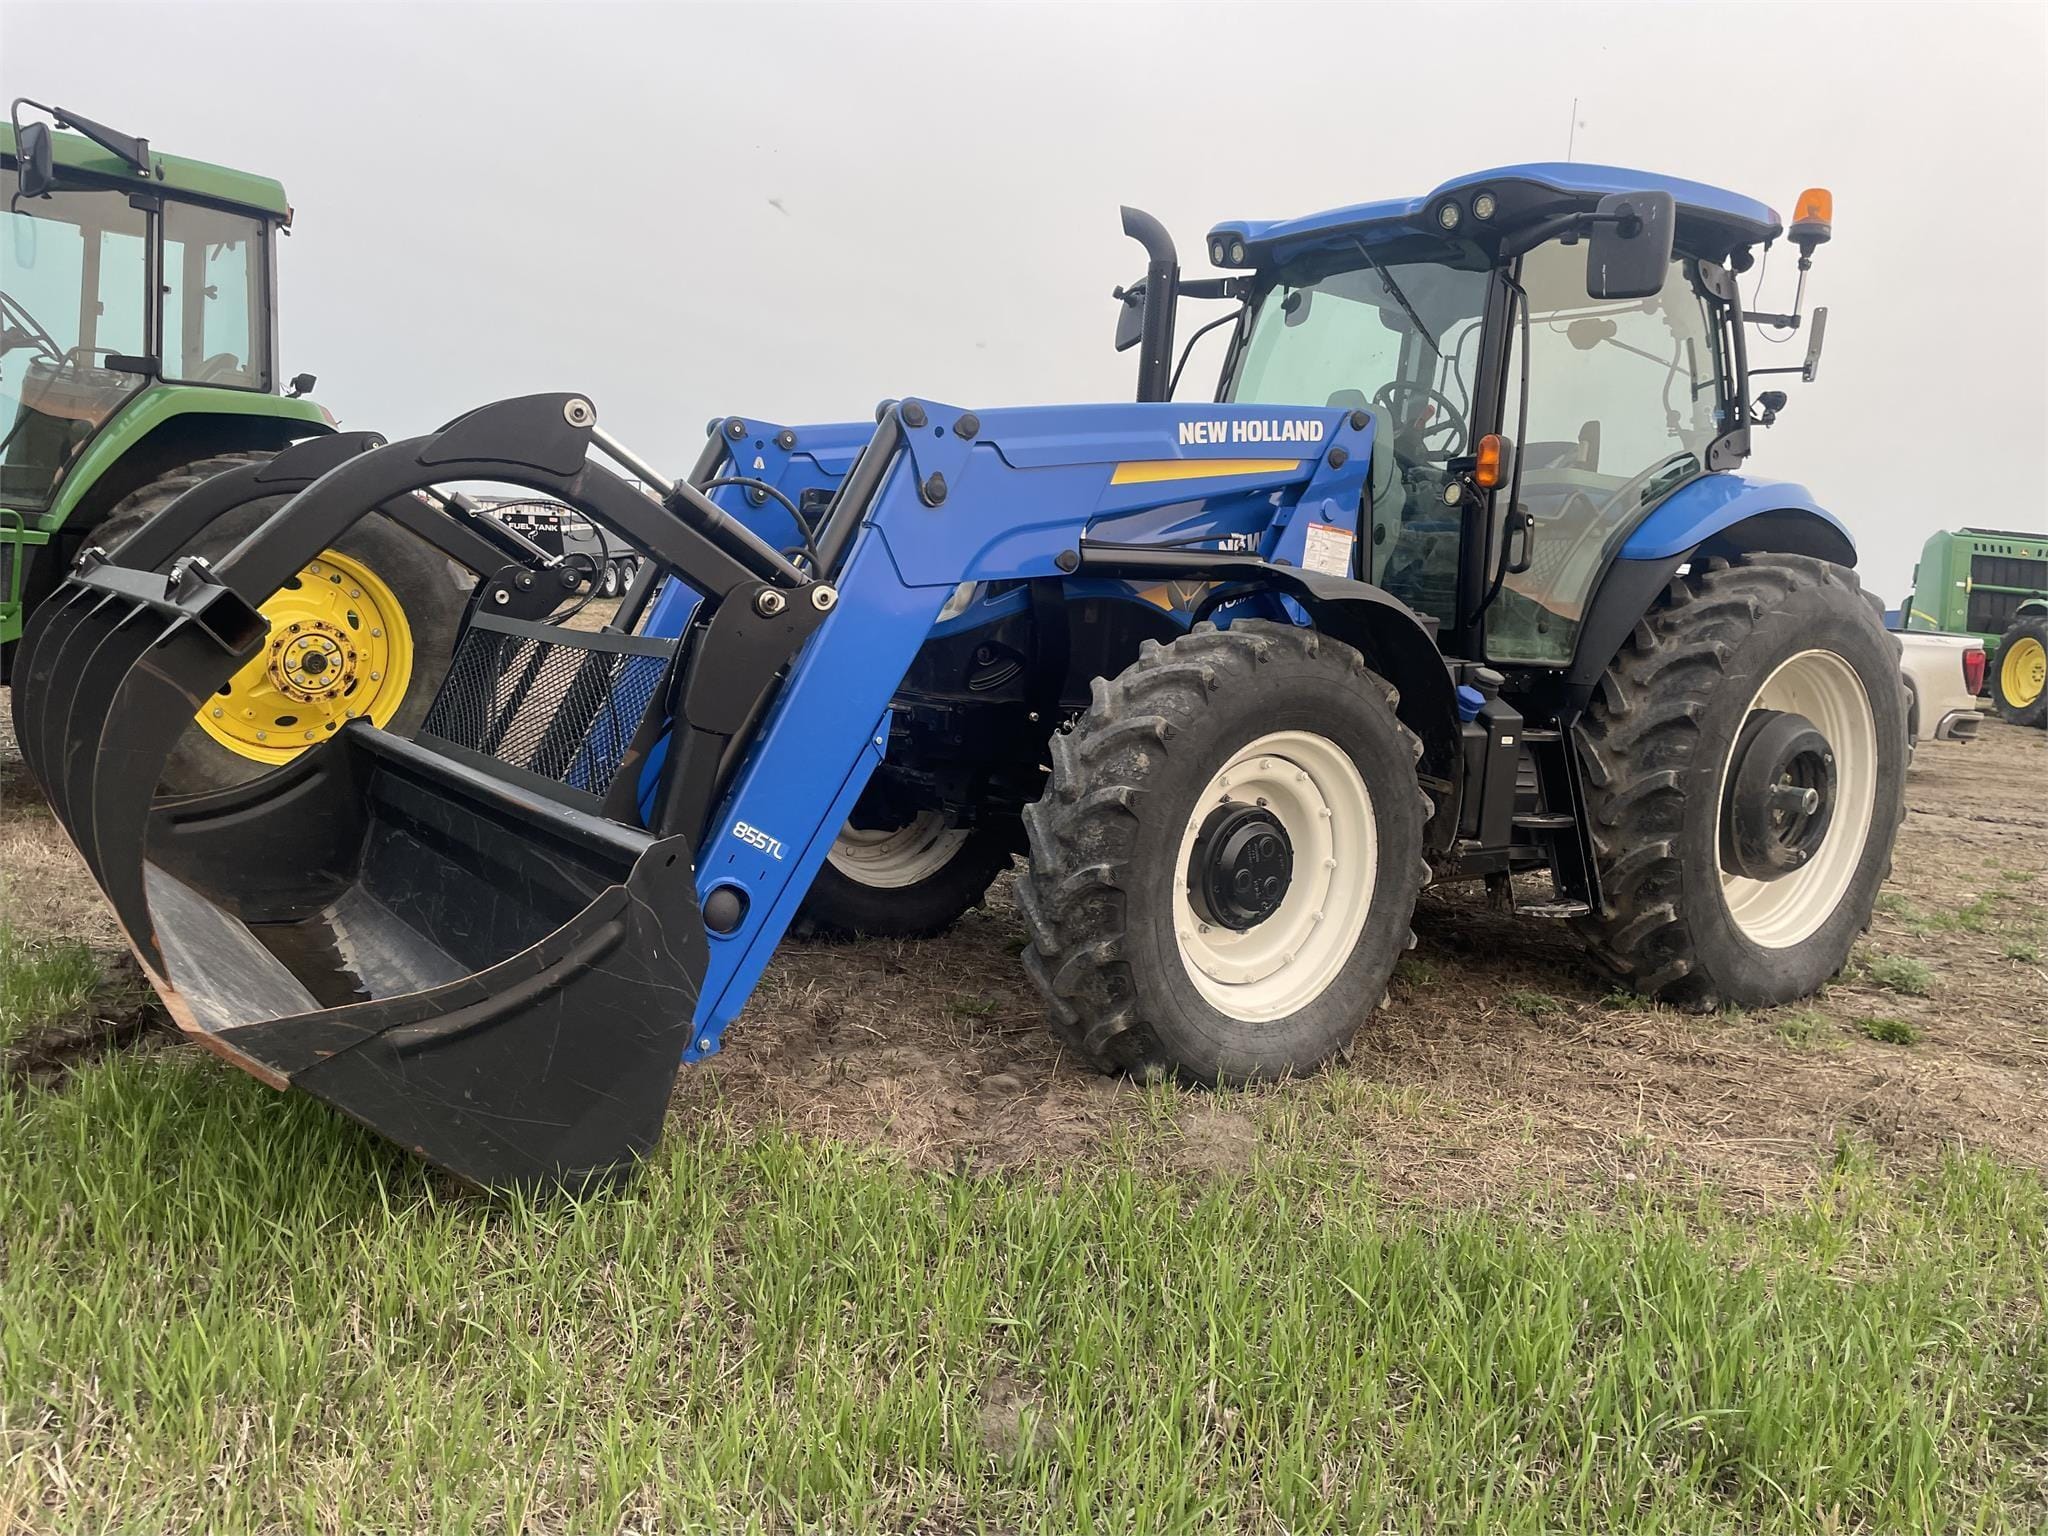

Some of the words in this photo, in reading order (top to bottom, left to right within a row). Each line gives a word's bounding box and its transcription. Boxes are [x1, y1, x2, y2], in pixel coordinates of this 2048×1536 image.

[1179, 421, 1228, 445] NEW
[1232, 420, 1324, 443] HOLLAND
[534, 523, 558, 531] TANK
[732, 821, 783, 860] 855TL
